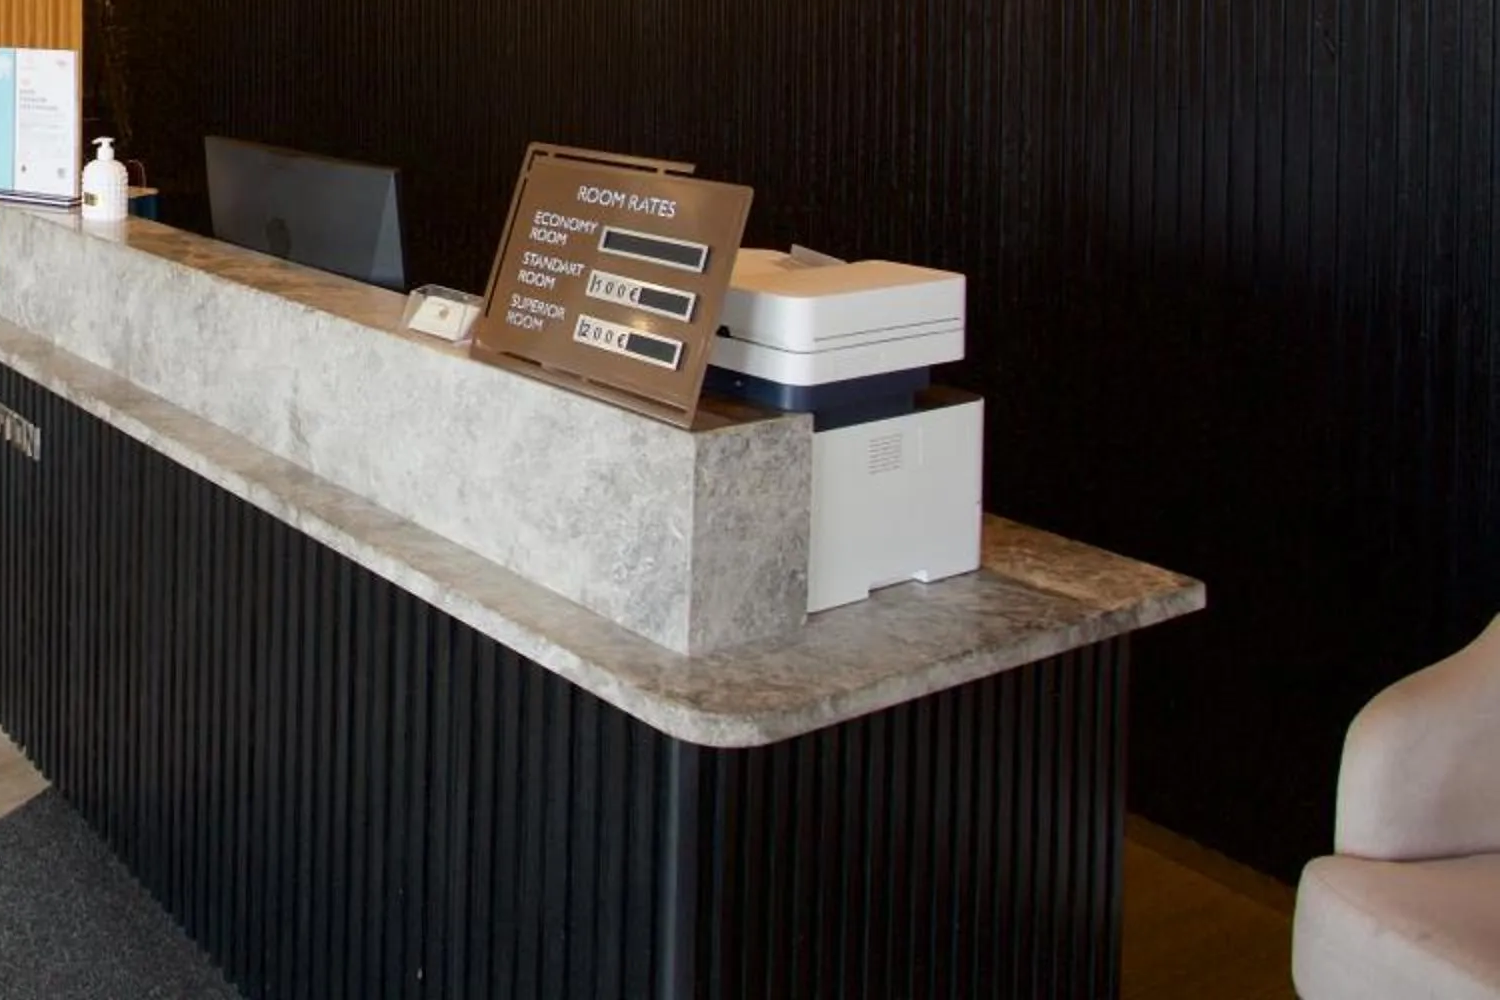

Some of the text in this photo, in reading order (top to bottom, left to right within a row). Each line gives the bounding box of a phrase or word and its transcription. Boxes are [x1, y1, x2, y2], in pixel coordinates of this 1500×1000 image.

[577, 185, 677, 218] ROOM RATES
[533, 211, 599, 234] ECONOMY
[529, 229, 568, 246] ROOM
[522, 252, 585, 277] STANDART
[517, 270, 556, 289] ROOM
[509, 295, 566, 320] SUPERIOR
[506, 311, 544, 331] ROOM
